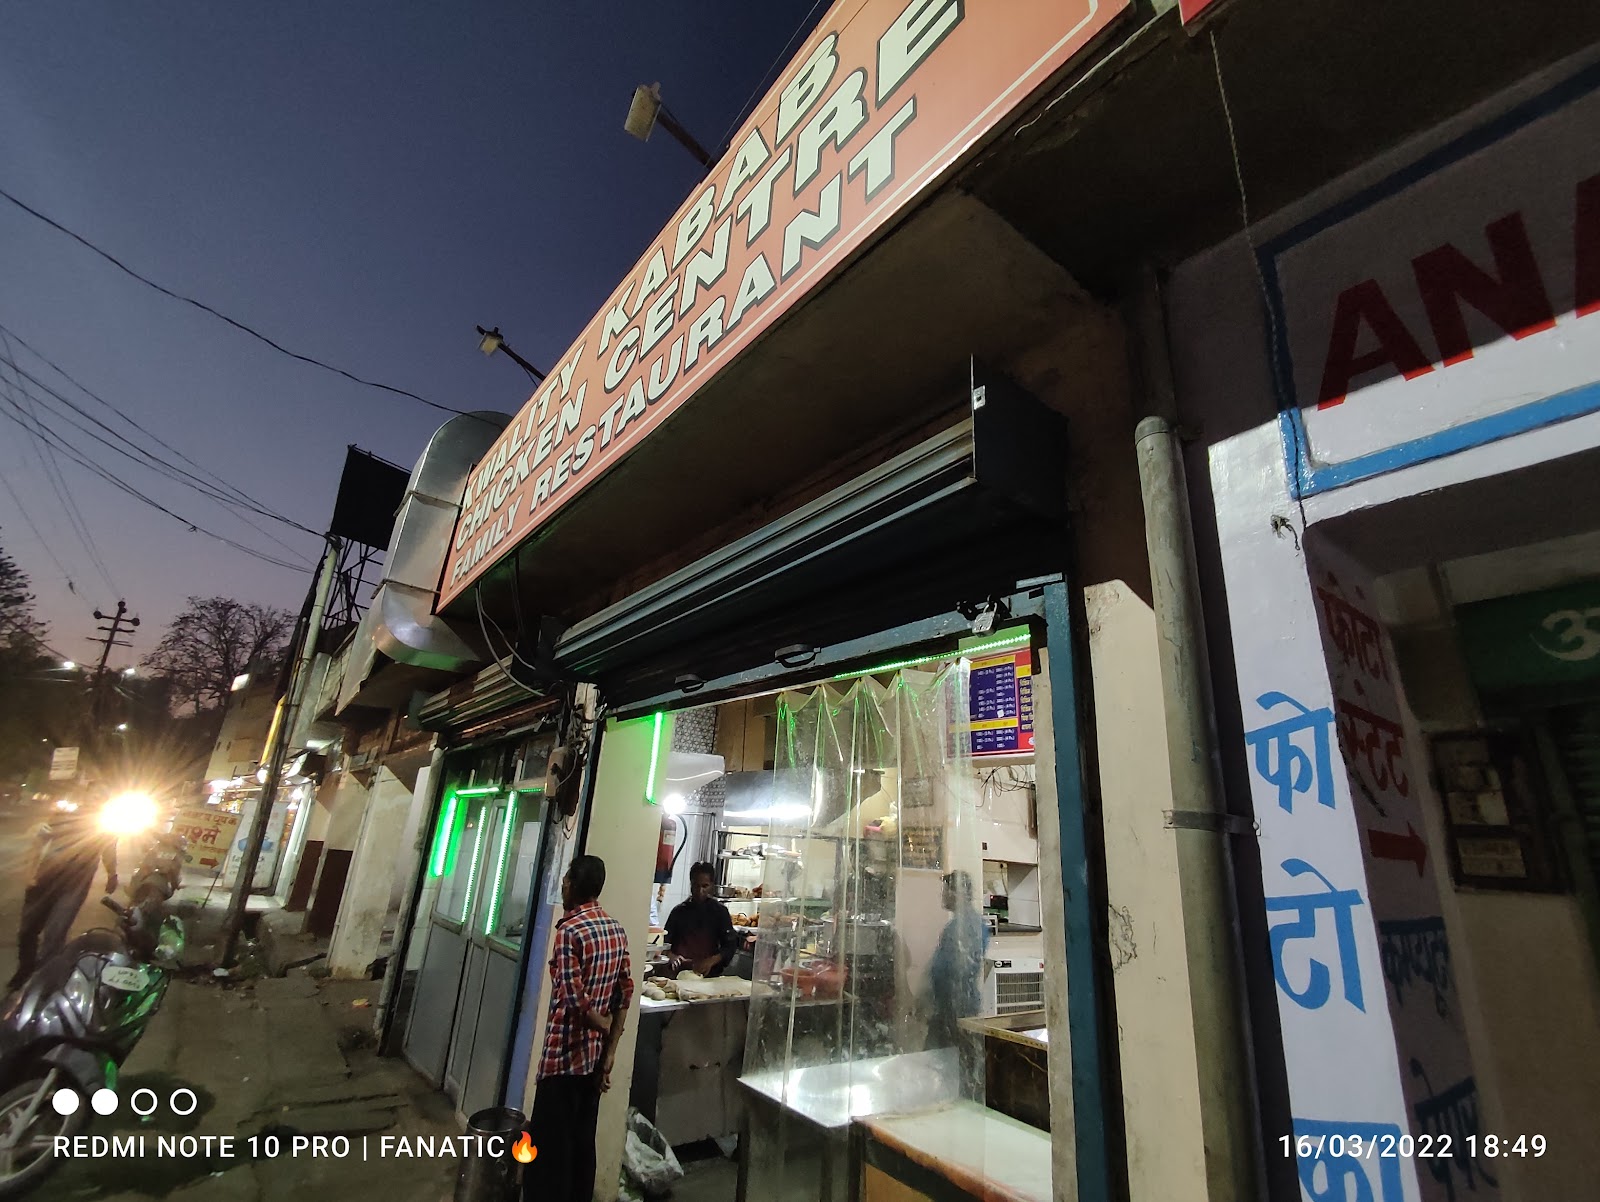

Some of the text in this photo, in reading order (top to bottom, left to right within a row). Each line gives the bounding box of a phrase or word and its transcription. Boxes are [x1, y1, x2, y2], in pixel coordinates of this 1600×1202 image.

[450, 95, 917, 588] FAMILY RESTAURANT
[456, 0, 966, 552] CHICKEN CENTRE
[460, 32, 839, 518] KWALITY KABAB
